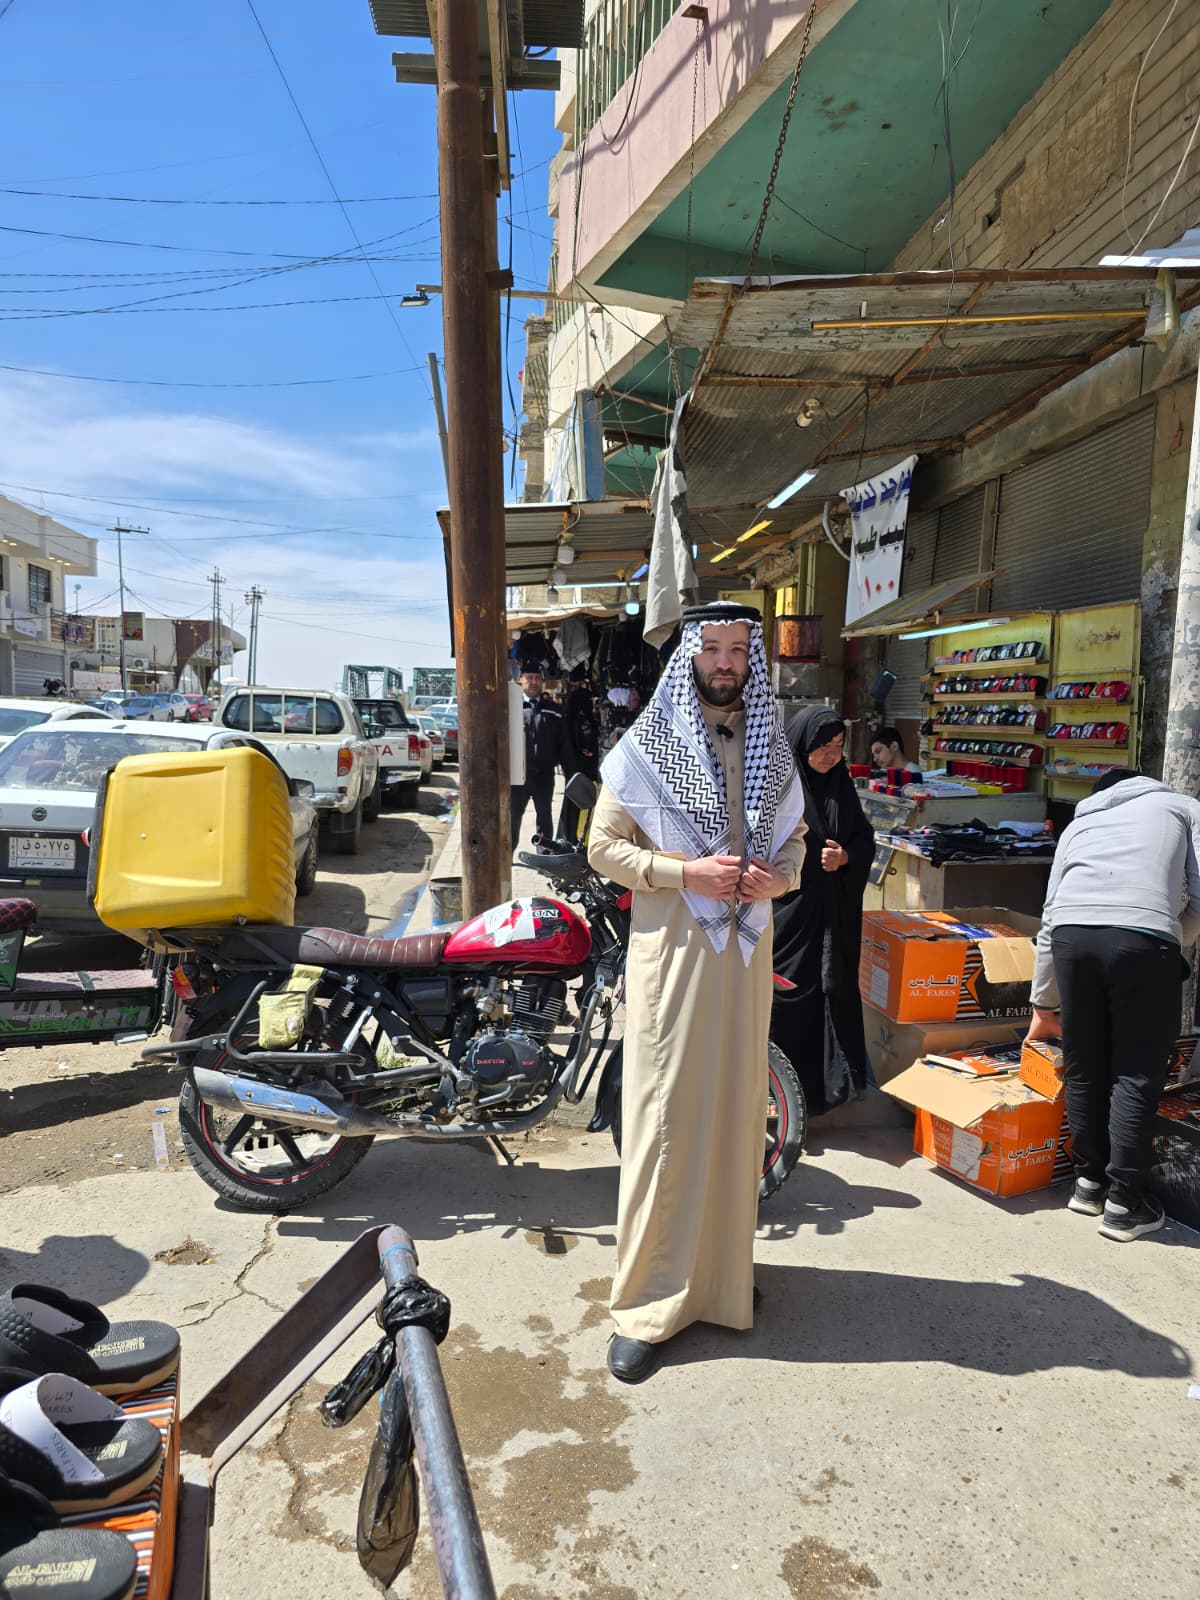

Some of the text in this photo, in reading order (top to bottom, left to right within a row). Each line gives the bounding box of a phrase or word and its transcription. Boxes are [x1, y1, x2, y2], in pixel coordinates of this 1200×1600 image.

[908, 975, 959, 989] الفارس
[910, 989, 957, 997] AL FARES
[987, 1009, 1002, 1017] AL
[1008, 1138, 1056, 1160] الفارس
[1025, 1154, 1053, 1168] FARES
